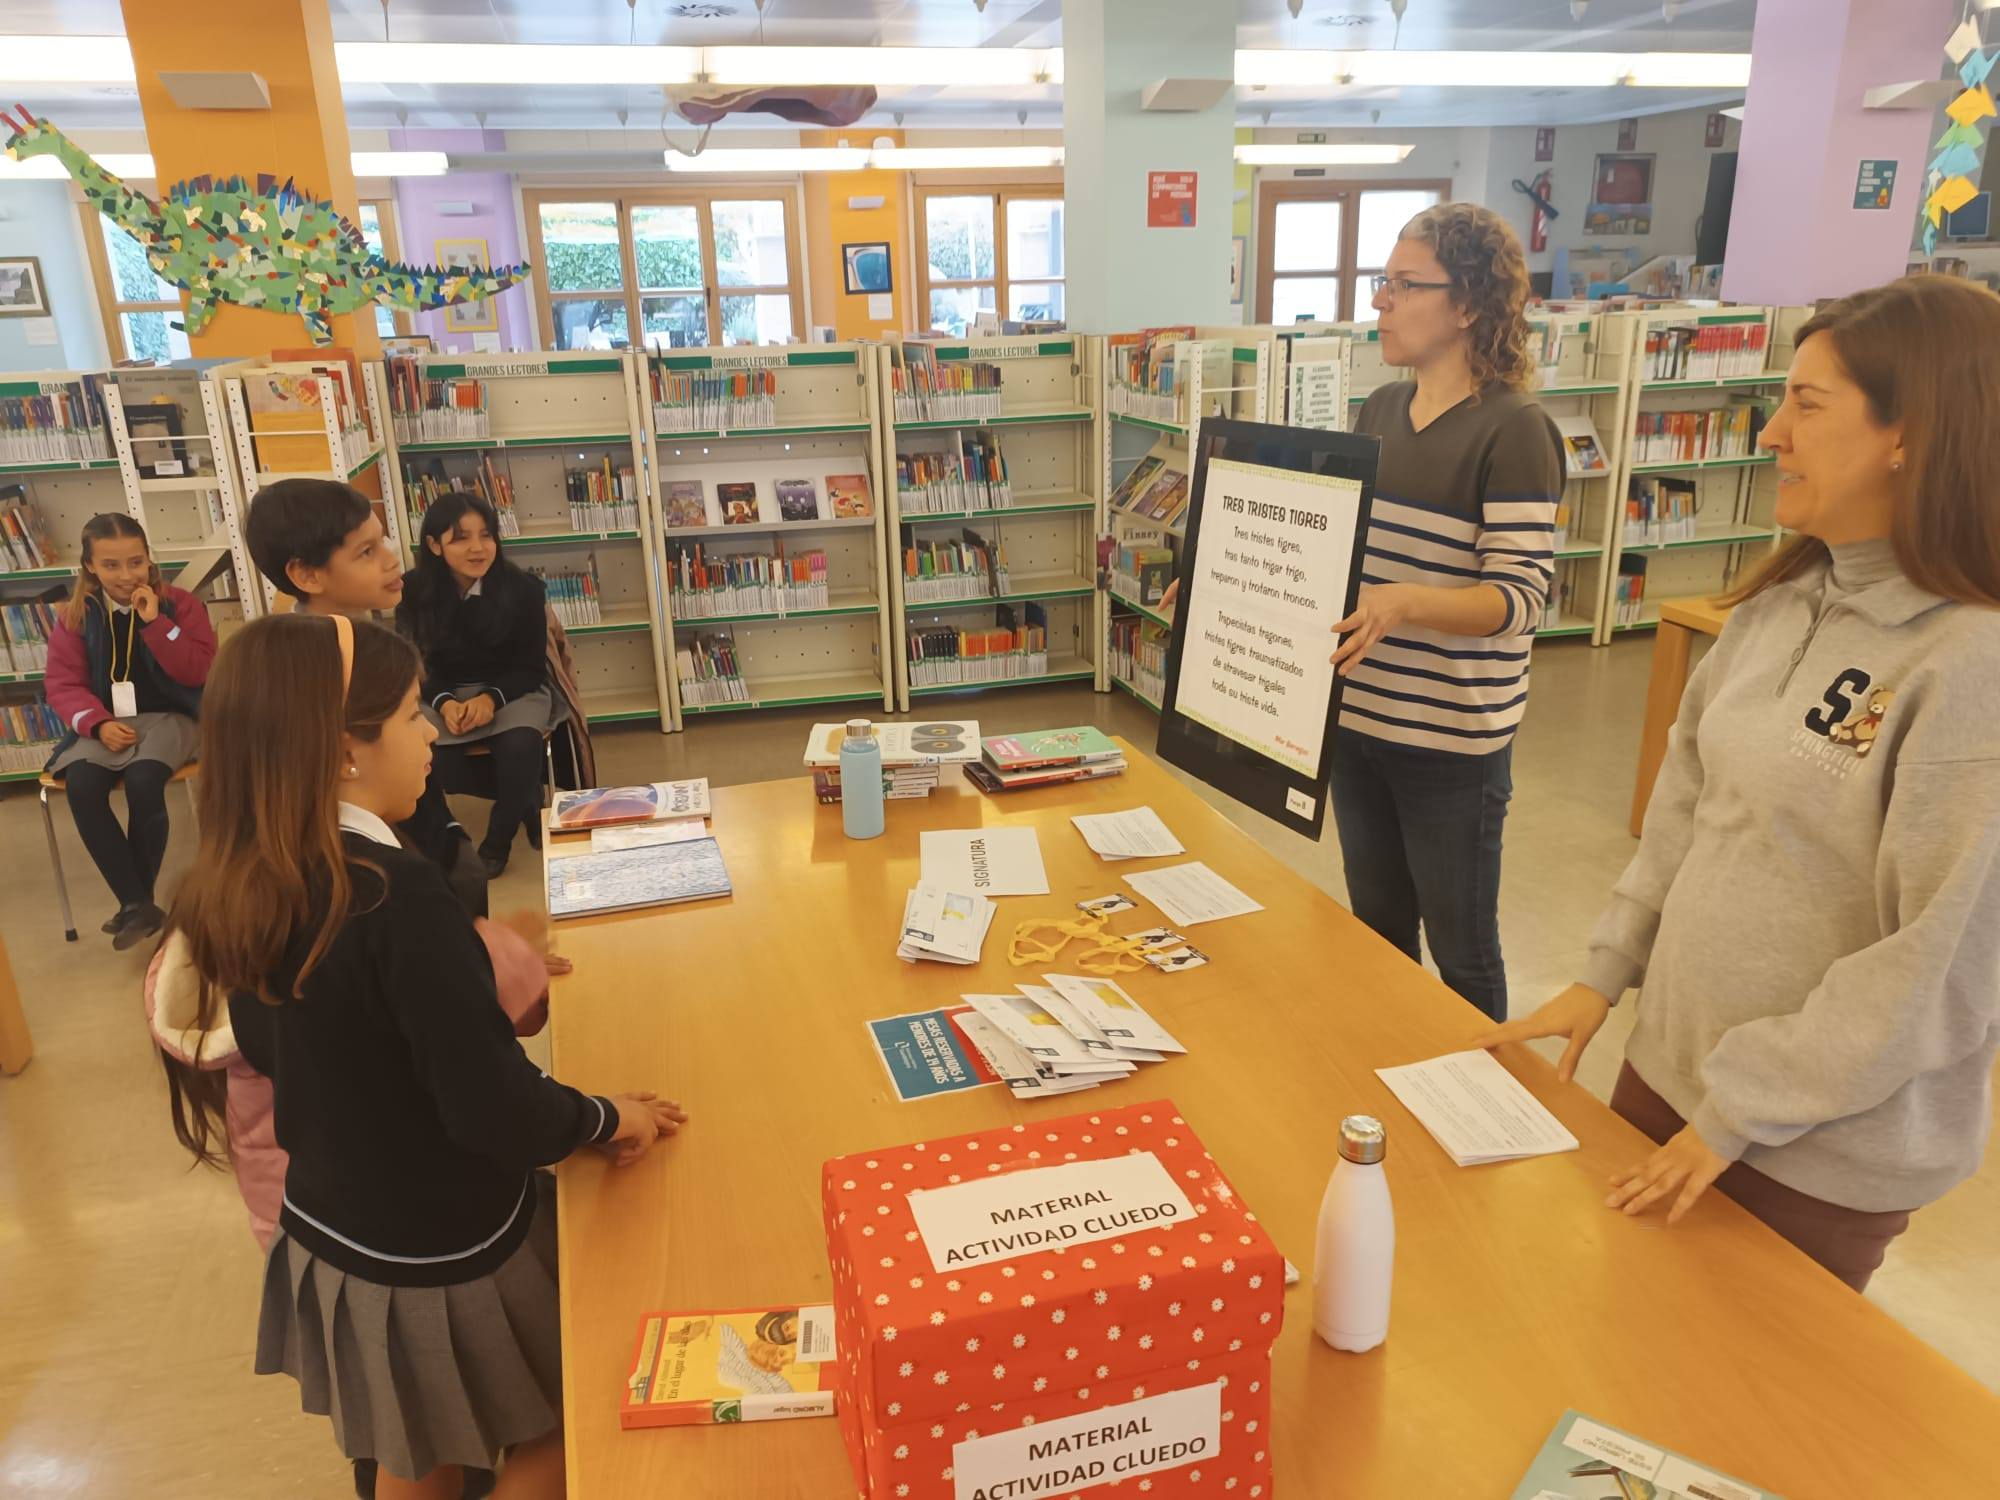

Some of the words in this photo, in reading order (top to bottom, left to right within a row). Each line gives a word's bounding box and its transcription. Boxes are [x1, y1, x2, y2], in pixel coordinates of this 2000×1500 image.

[714, 356, 748, 368] GRANDES
[750, 355, 787, 368] LECTORES
[970, 346, 1002, 358] GRANDES
[1004, 345, 1038, 358] LECTORES
[466, 365, 504, 376] GRANDES
[506, 363, 547, 376] LECTORES
[41, 382, 67, 395] GRAN
[1222, 495, 1244, 514] TRES
[1248, 500, 1286, 523] TRISTES
[1290, 508, 1328, 532] TIGRES
[1234, 526, 1248, 540] Tres
[1251, 530, 1274, 547] tristes
[1278, 536, 1302, 555] tigres,
[1224, 548, 1238, 562] tras
[1240, 551, 1259, 568] tanto
[1262, 558, 1283, 576] trigar
[1286, 564, 1307, 582] trigo,
[1210, 568, 1240, 586] treparon
[1241, 580, 1247, 592] y
[1248, 580, 1280, 599] trotaron
[1283, 588, 1318, 610] troncos.
[1204, 629, 1225, 647] tristes
[1226, 638, 1246, 656] tigres
[1249, 646, 1304, 678] traumatizados
[1258, 625, 1294, 650] tragones,
[1212, 656, 1222, 668] de
[1240, 688, 1259, 708] triste
[1260, 698, 1280, 717] vida.
[1804, 668, 1870, 736] S
[970, 838, 990, 888] SIGNATURA
[908, 1021, 930, 1049] MENORES
[922, 1047, 936, 1058] DE
[924, 1018, 944, 1038] MESAS
[990, 1189, 1112, 1226] MATERIAL
[946, 1224, 1078, 1264] ACTIVIDAD
[1083, 1202, 1178, 1234] CLUEDO
[1029, 1416, 1152, 1461] MATERIAL
[972, 1461, 1104, 1500] ACTIVIDAD
[1112, 1436, 1206, 1472] CLUEDO
